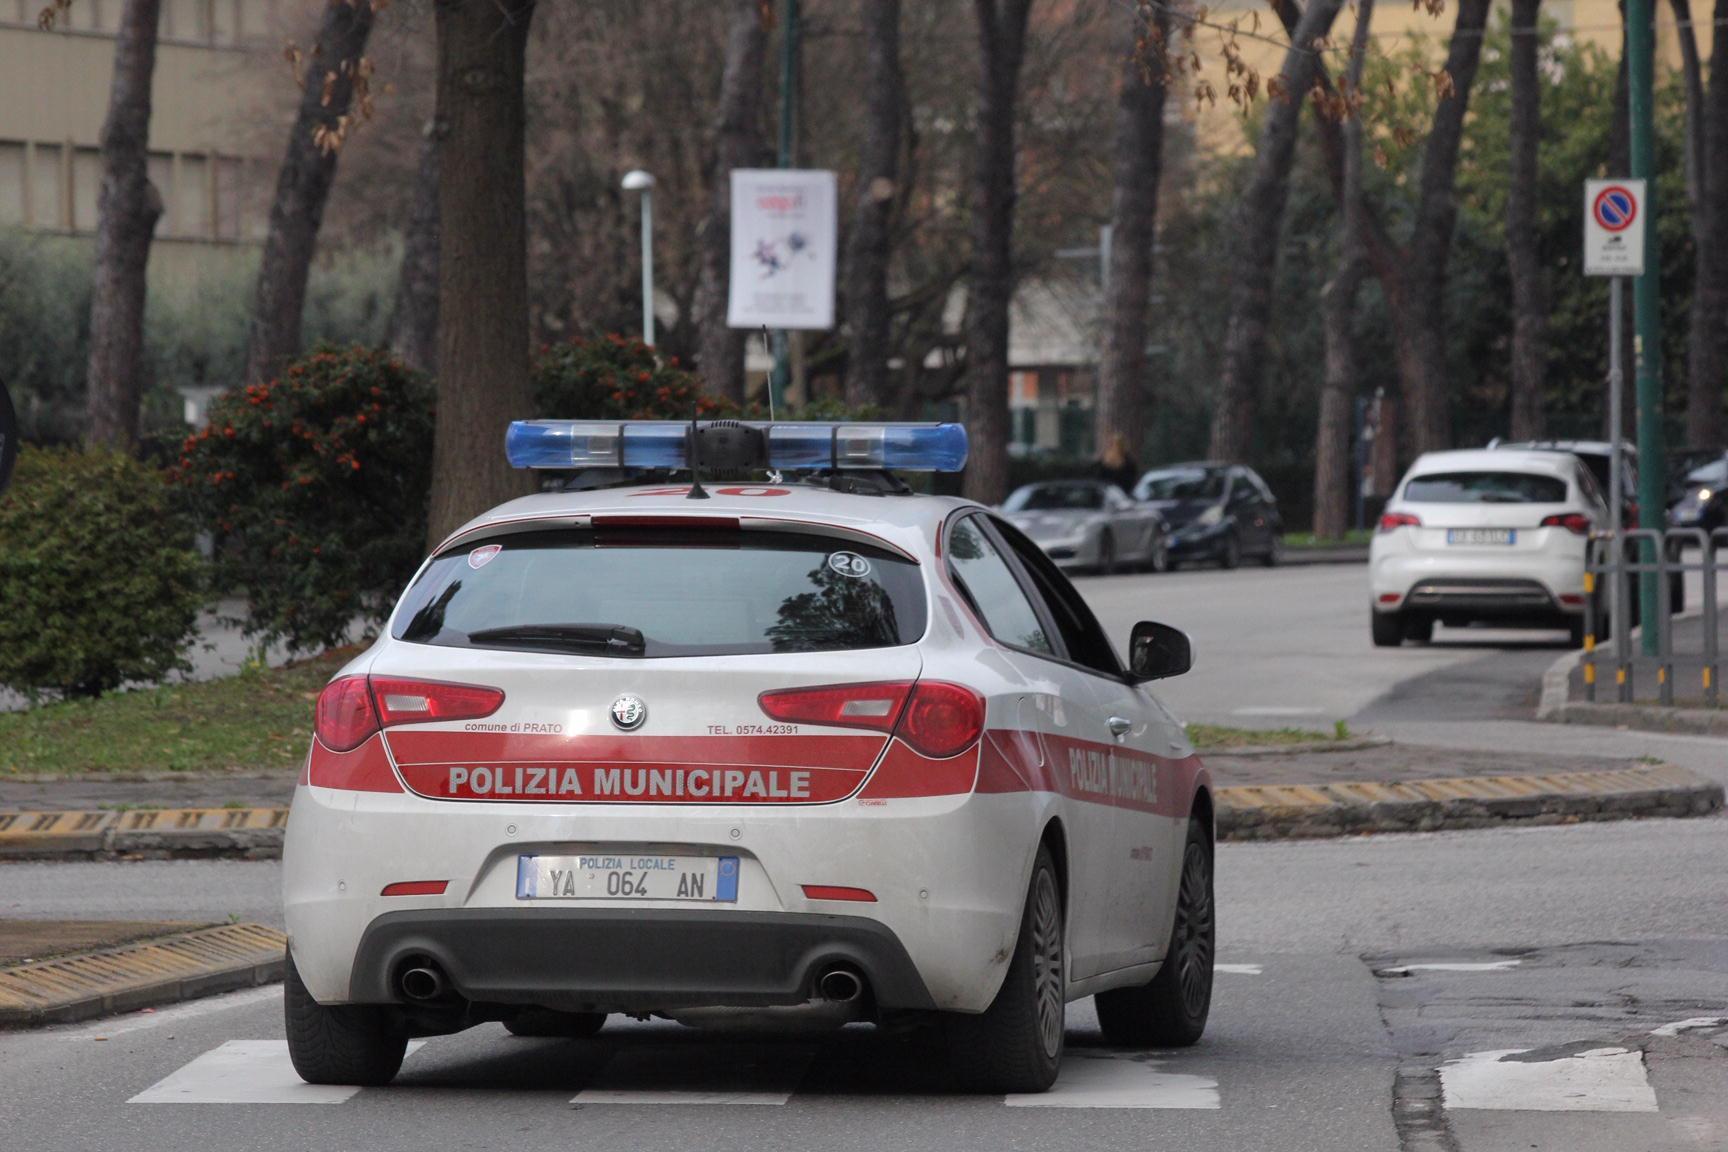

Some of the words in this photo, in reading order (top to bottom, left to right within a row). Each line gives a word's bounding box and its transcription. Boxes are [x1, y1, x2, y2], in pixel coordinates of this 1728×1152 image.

[834, 555, 866, 572] 20
[465, 722, 508, 732] comune
[510, 722, 521, 732] di
[523, 723, 562, 733] PRATO
[707, 725, 733, 735] TEL.
[736, 725, 799, 735] 0574.42391
[1068, 747, 1107, 795] POLIZIA
[449, 767, 582, 794] POLIZIA
[594, 769, 810, 798] MUNICIPALE
[579, 857, 622, 870] POLIZIA
[630, 858, 675, 871] LOCALE
[550, 871, 575, 896] YA
[607, 871, 647, 897] 064
[677, 872, 704, 898] AN
